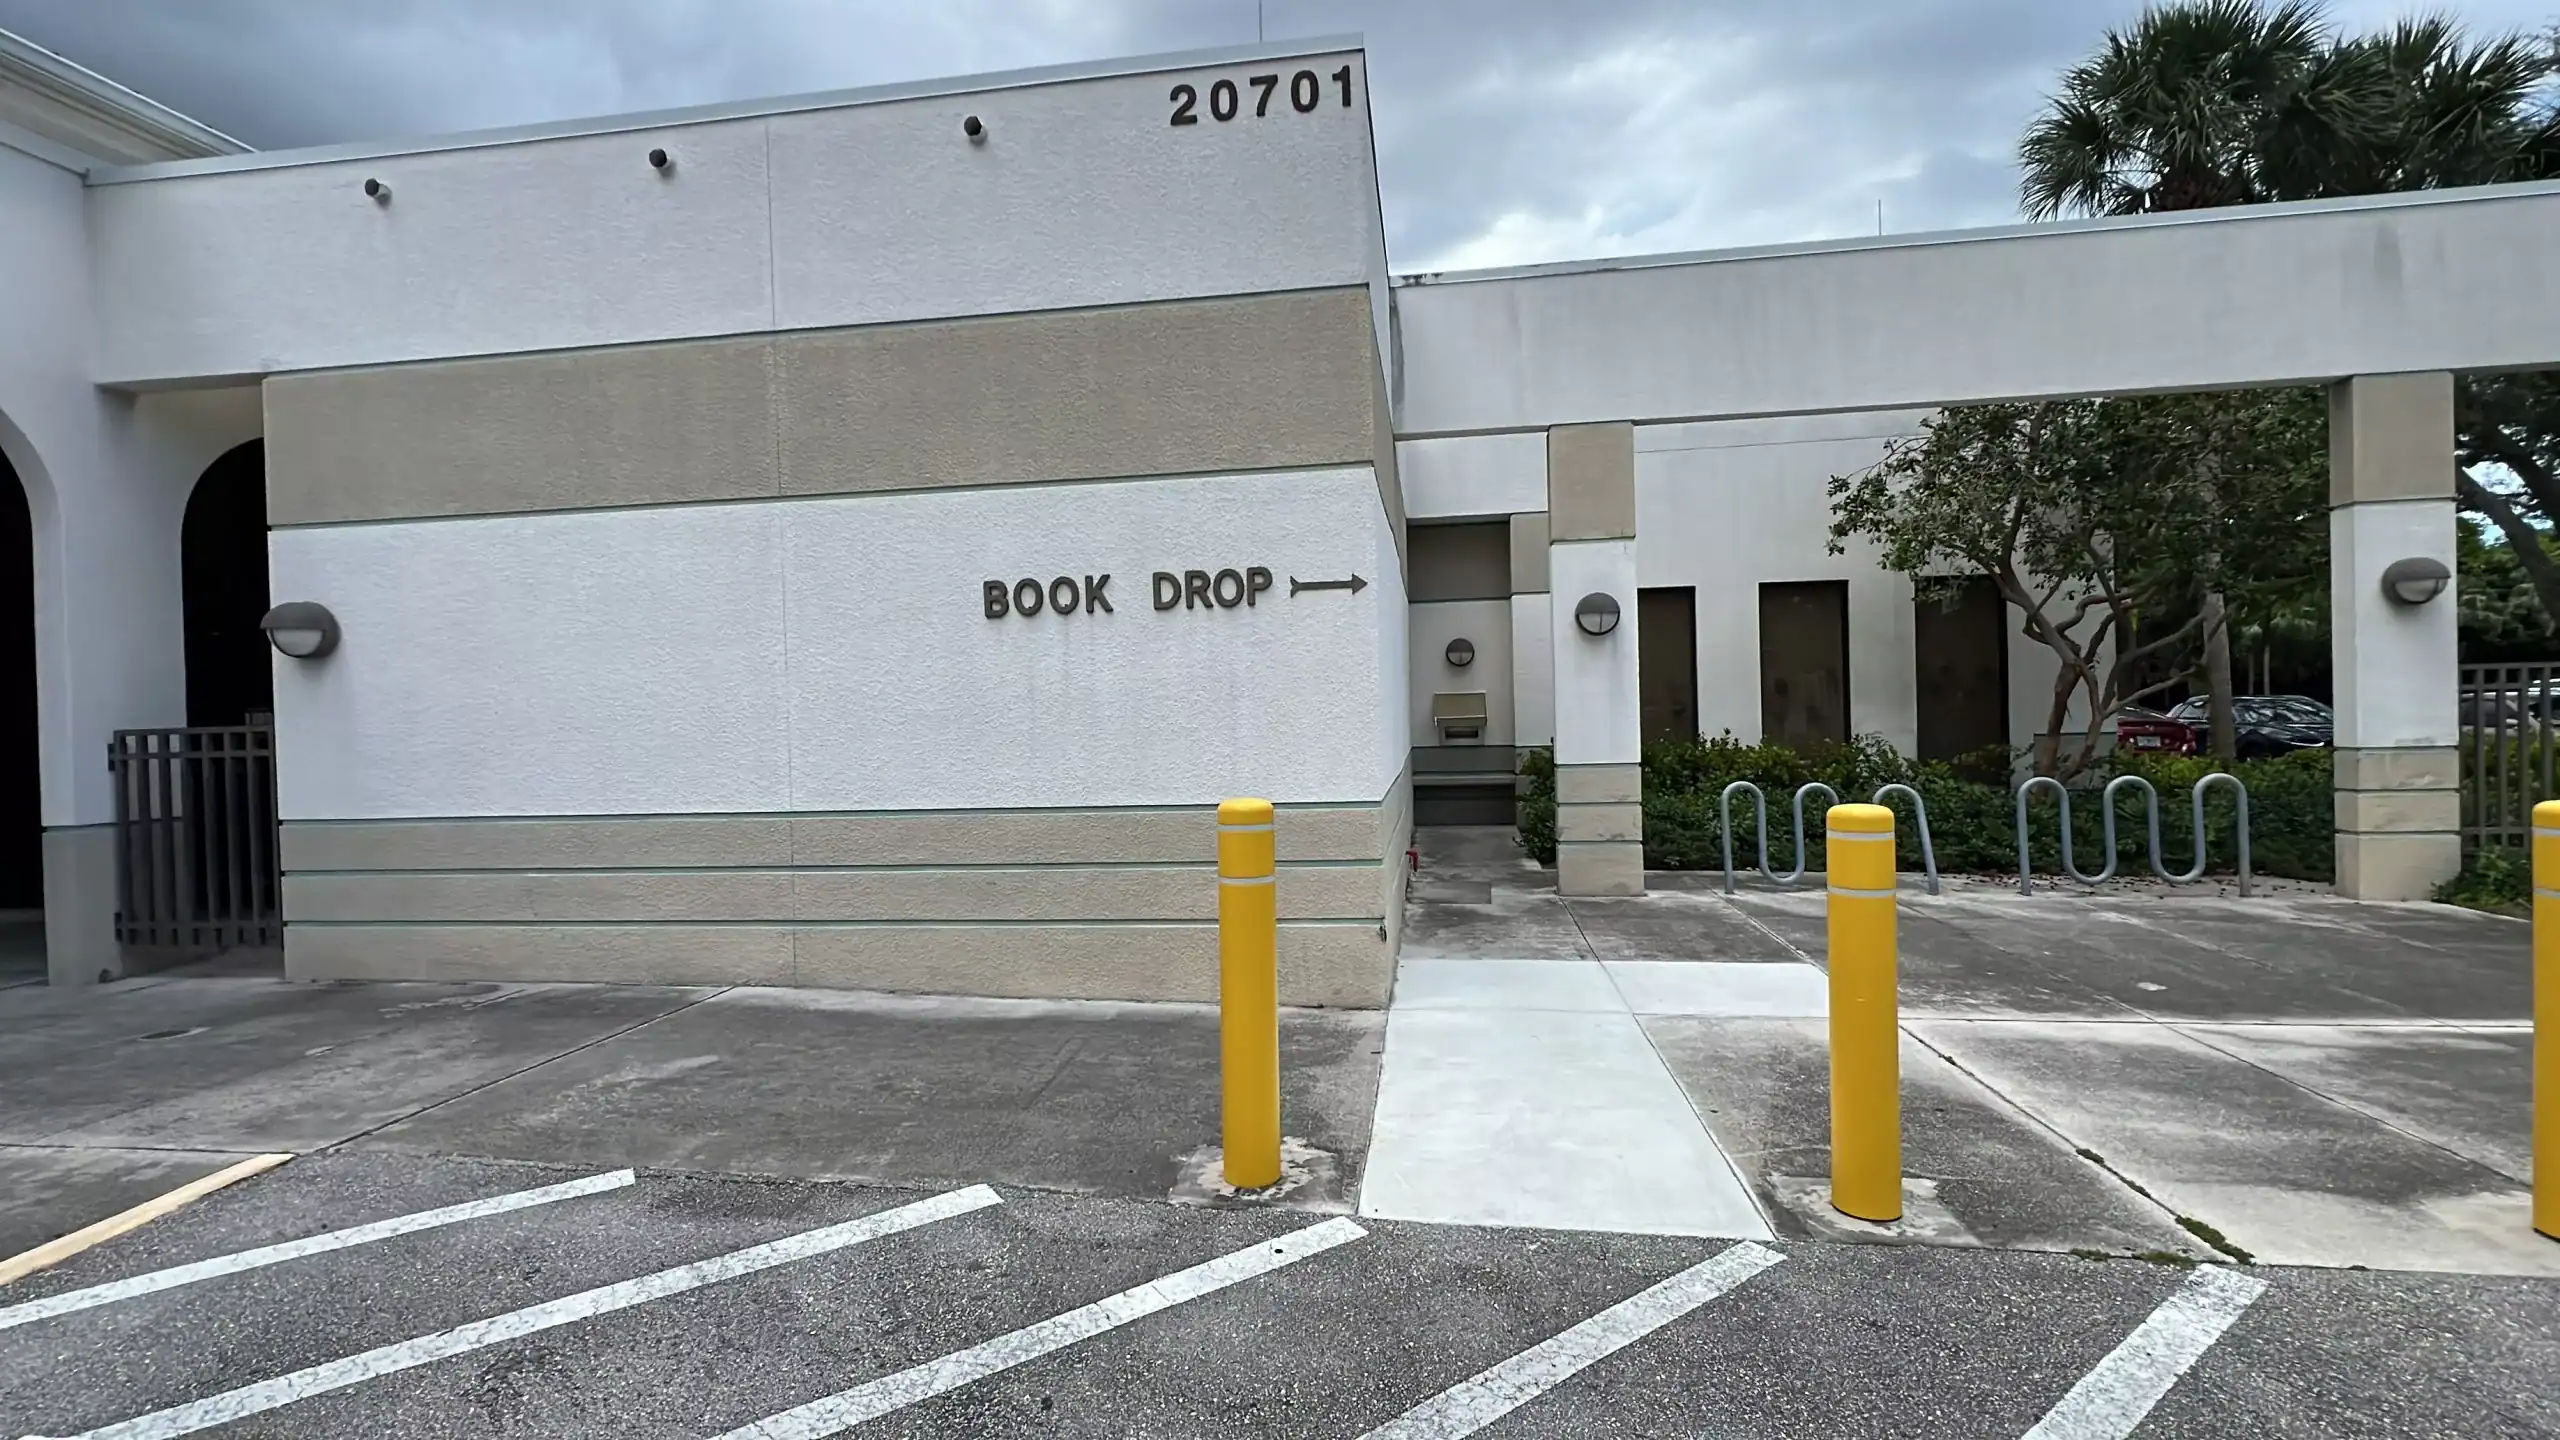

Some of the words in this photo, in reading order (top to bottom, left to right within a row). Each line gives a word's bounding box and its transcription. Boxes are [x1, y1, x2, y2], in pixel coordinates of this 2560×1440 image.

[1170, 65, 1351, 126] 20701
[983, 574, 1113, 618] BOOK
[1152, 567, 1273, 610] DROP
